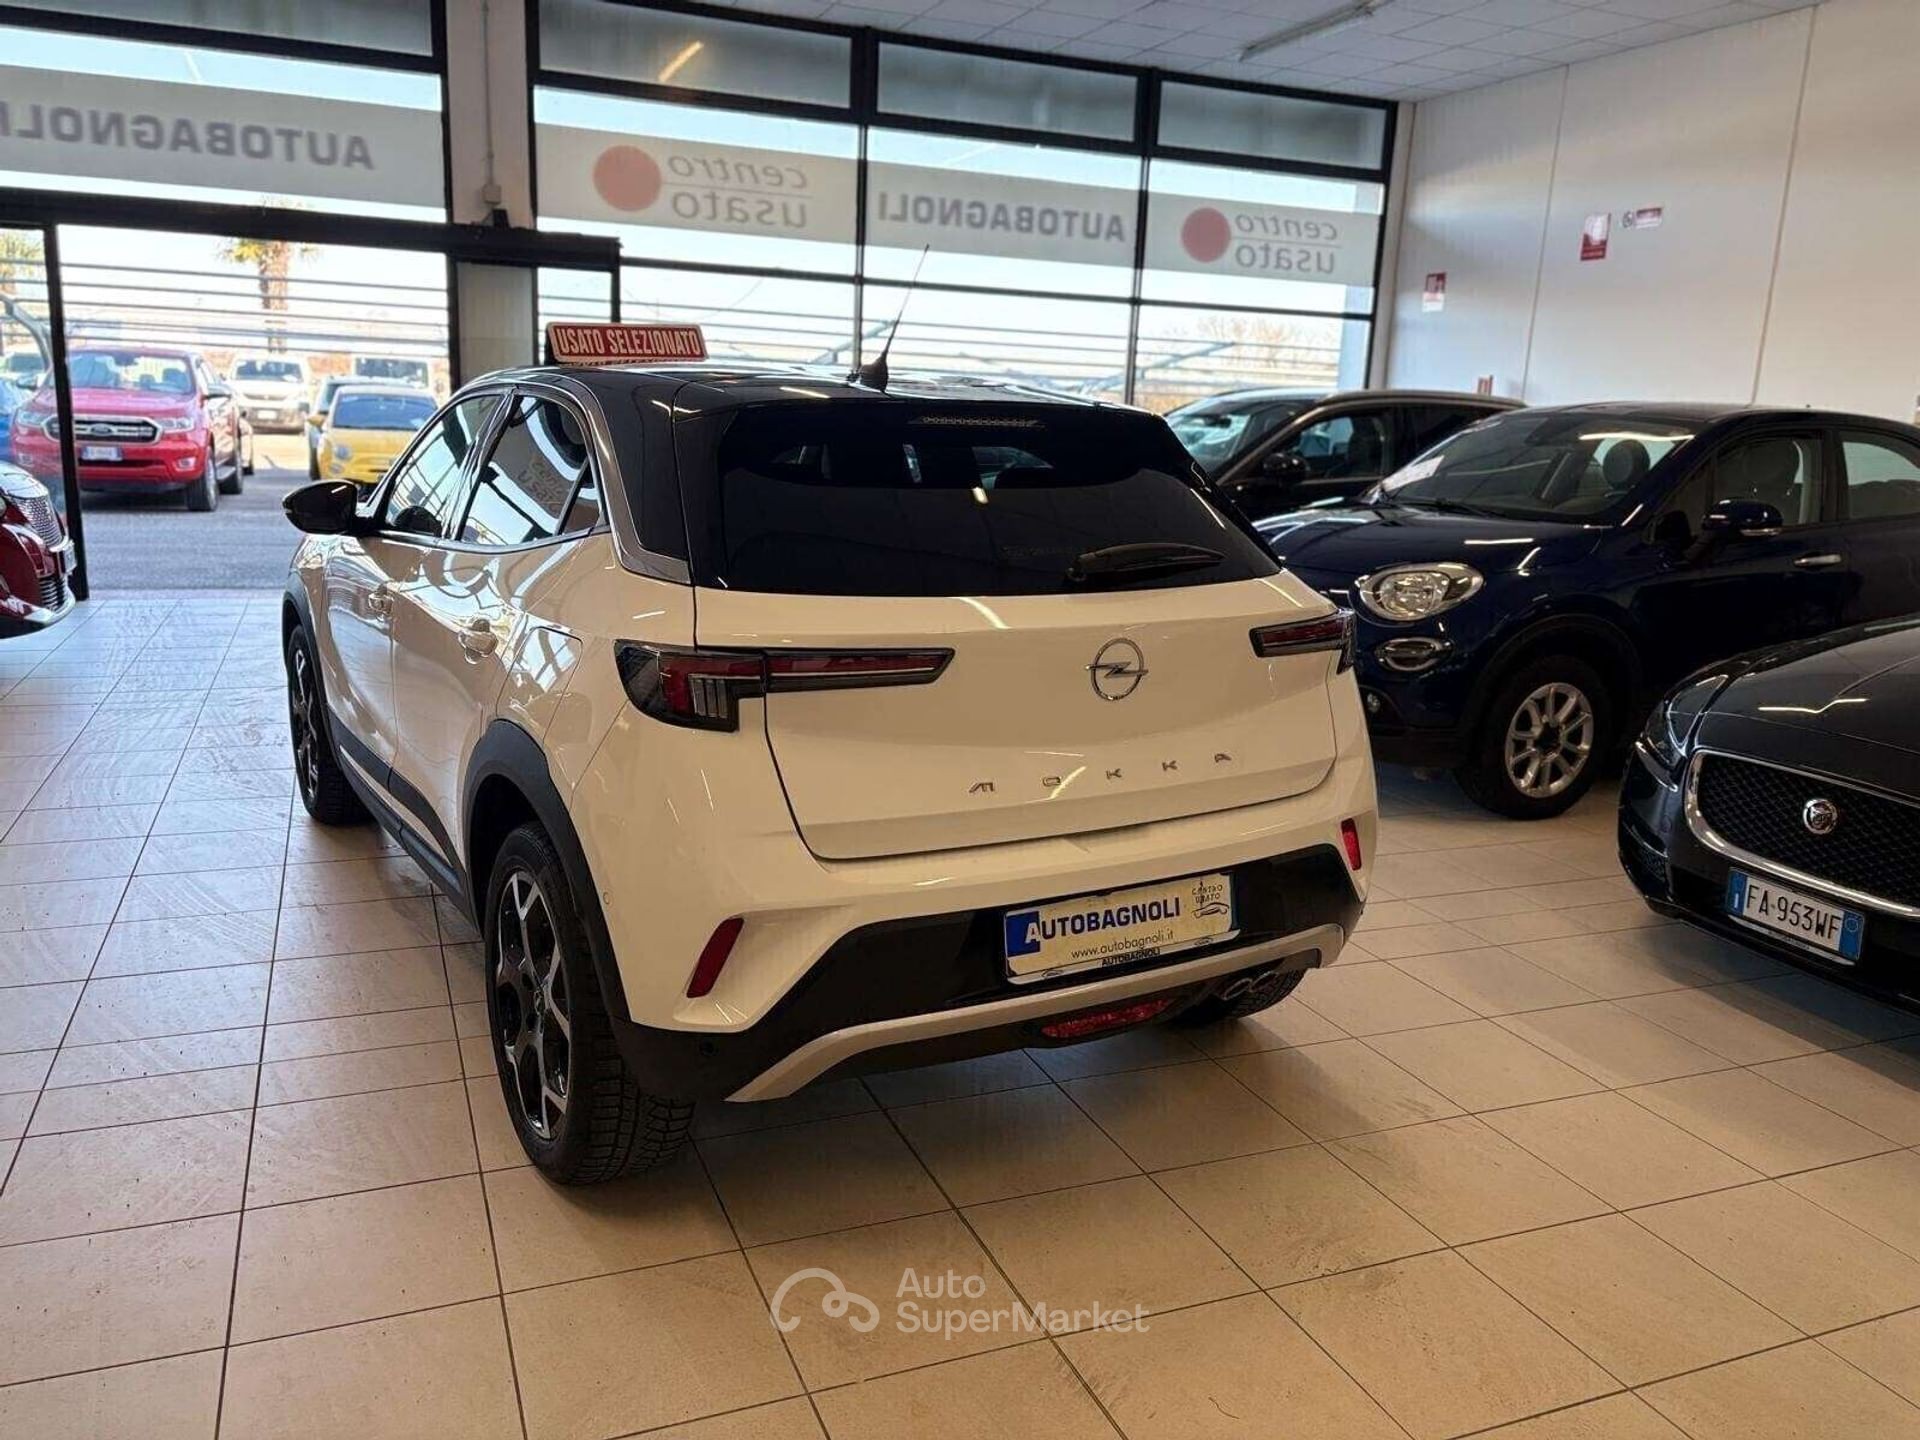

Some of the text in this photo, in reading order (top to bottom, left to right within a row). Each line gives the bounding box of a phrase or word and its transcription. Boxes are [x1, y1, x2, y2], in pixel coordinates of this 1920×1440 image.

[556, 327, 701, 355] USATO SELEZIONATO
[1024, 897, 1180, 944] AUTOBAGNOLI
[1071, 929, 1174, 959] www.autobagnoli.it
[1101, 946, 1161, 967] AUTOBAGNOLI
